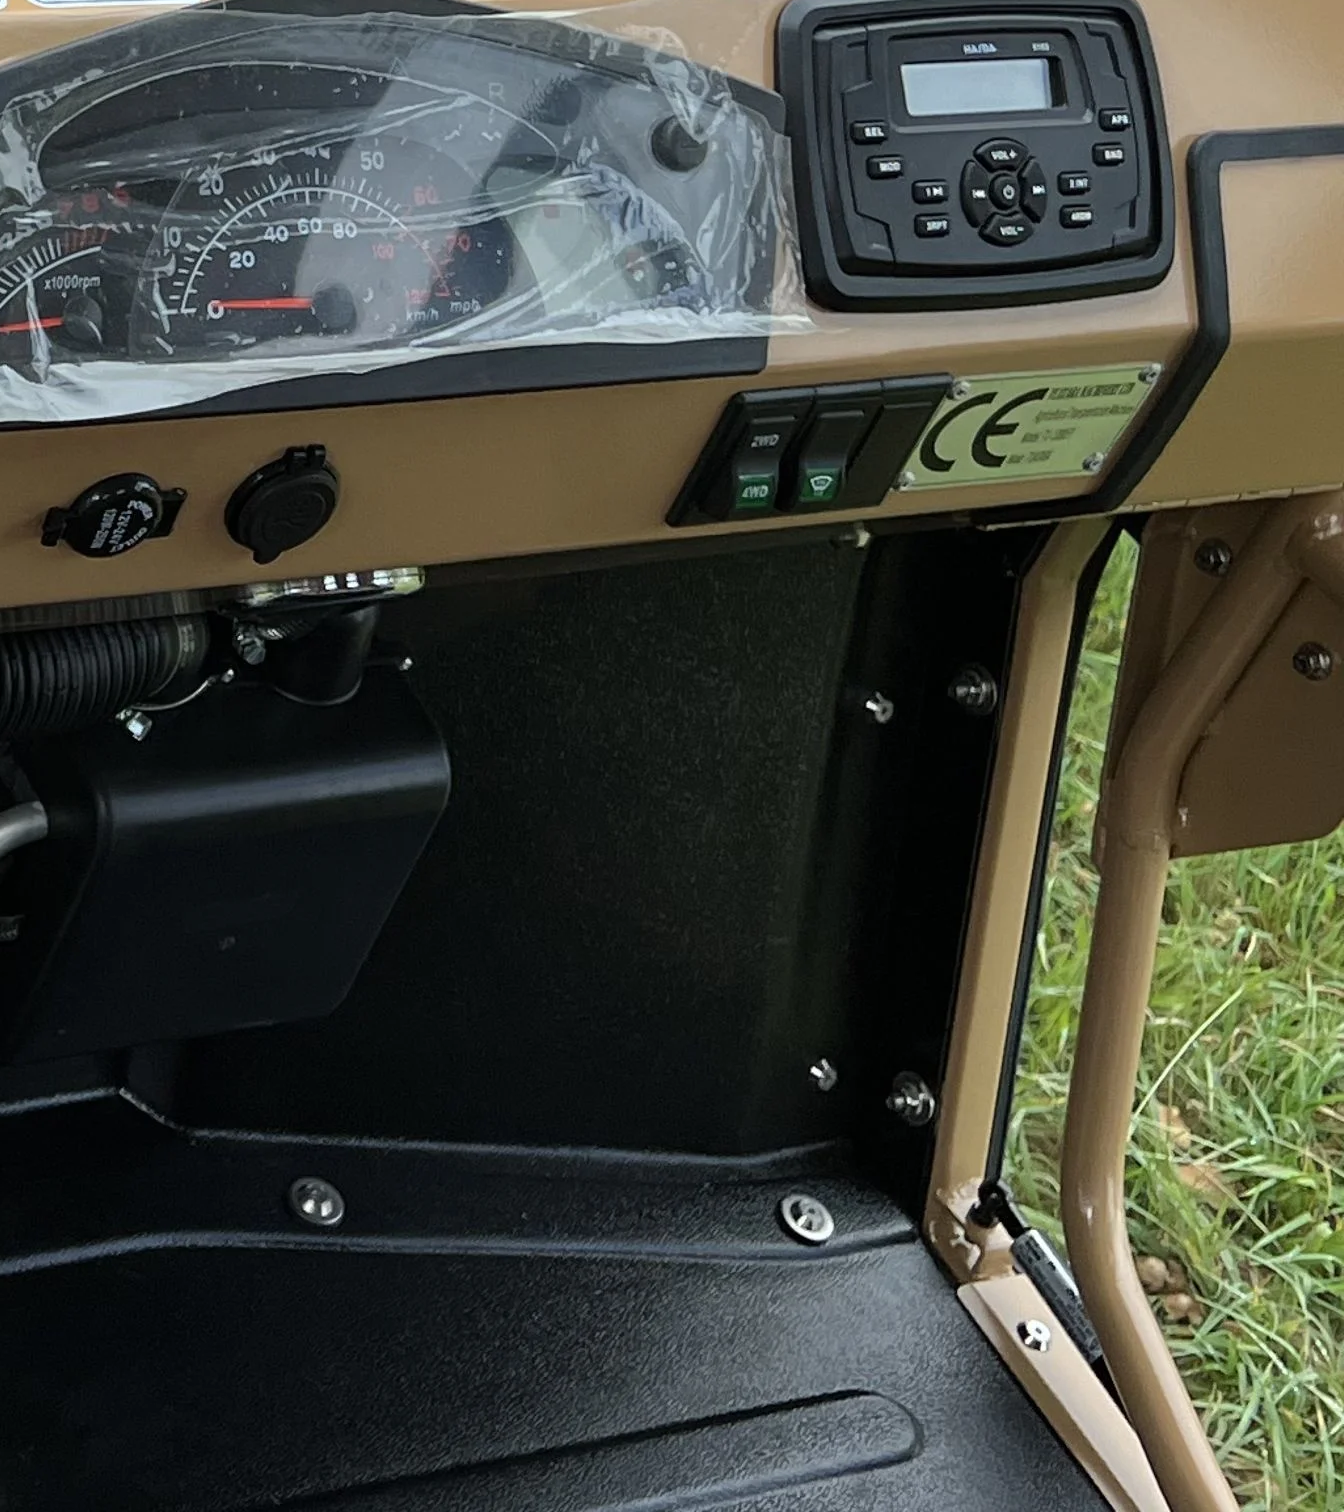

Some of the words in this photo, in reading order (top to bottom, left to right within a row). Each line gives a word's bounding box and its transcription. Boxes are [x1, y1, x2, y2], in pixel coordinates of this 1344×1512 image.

[361, 151, 385, 171] 50
[265, 225, 289, 243] 40
[298, 218, 322, 235] 60
[332, 221, 357, 239] 80
[164, 226, 182, 248] 10
[229, 250, 255, 269] 20
[44, 275, 101, 292] x1000rpm
[406, 307, 439, 322] km/h
[920, 387, 1050, 472] CE
[751, 433, 780, 449] 2WD
[742, 484, 769, 499] 4WD
